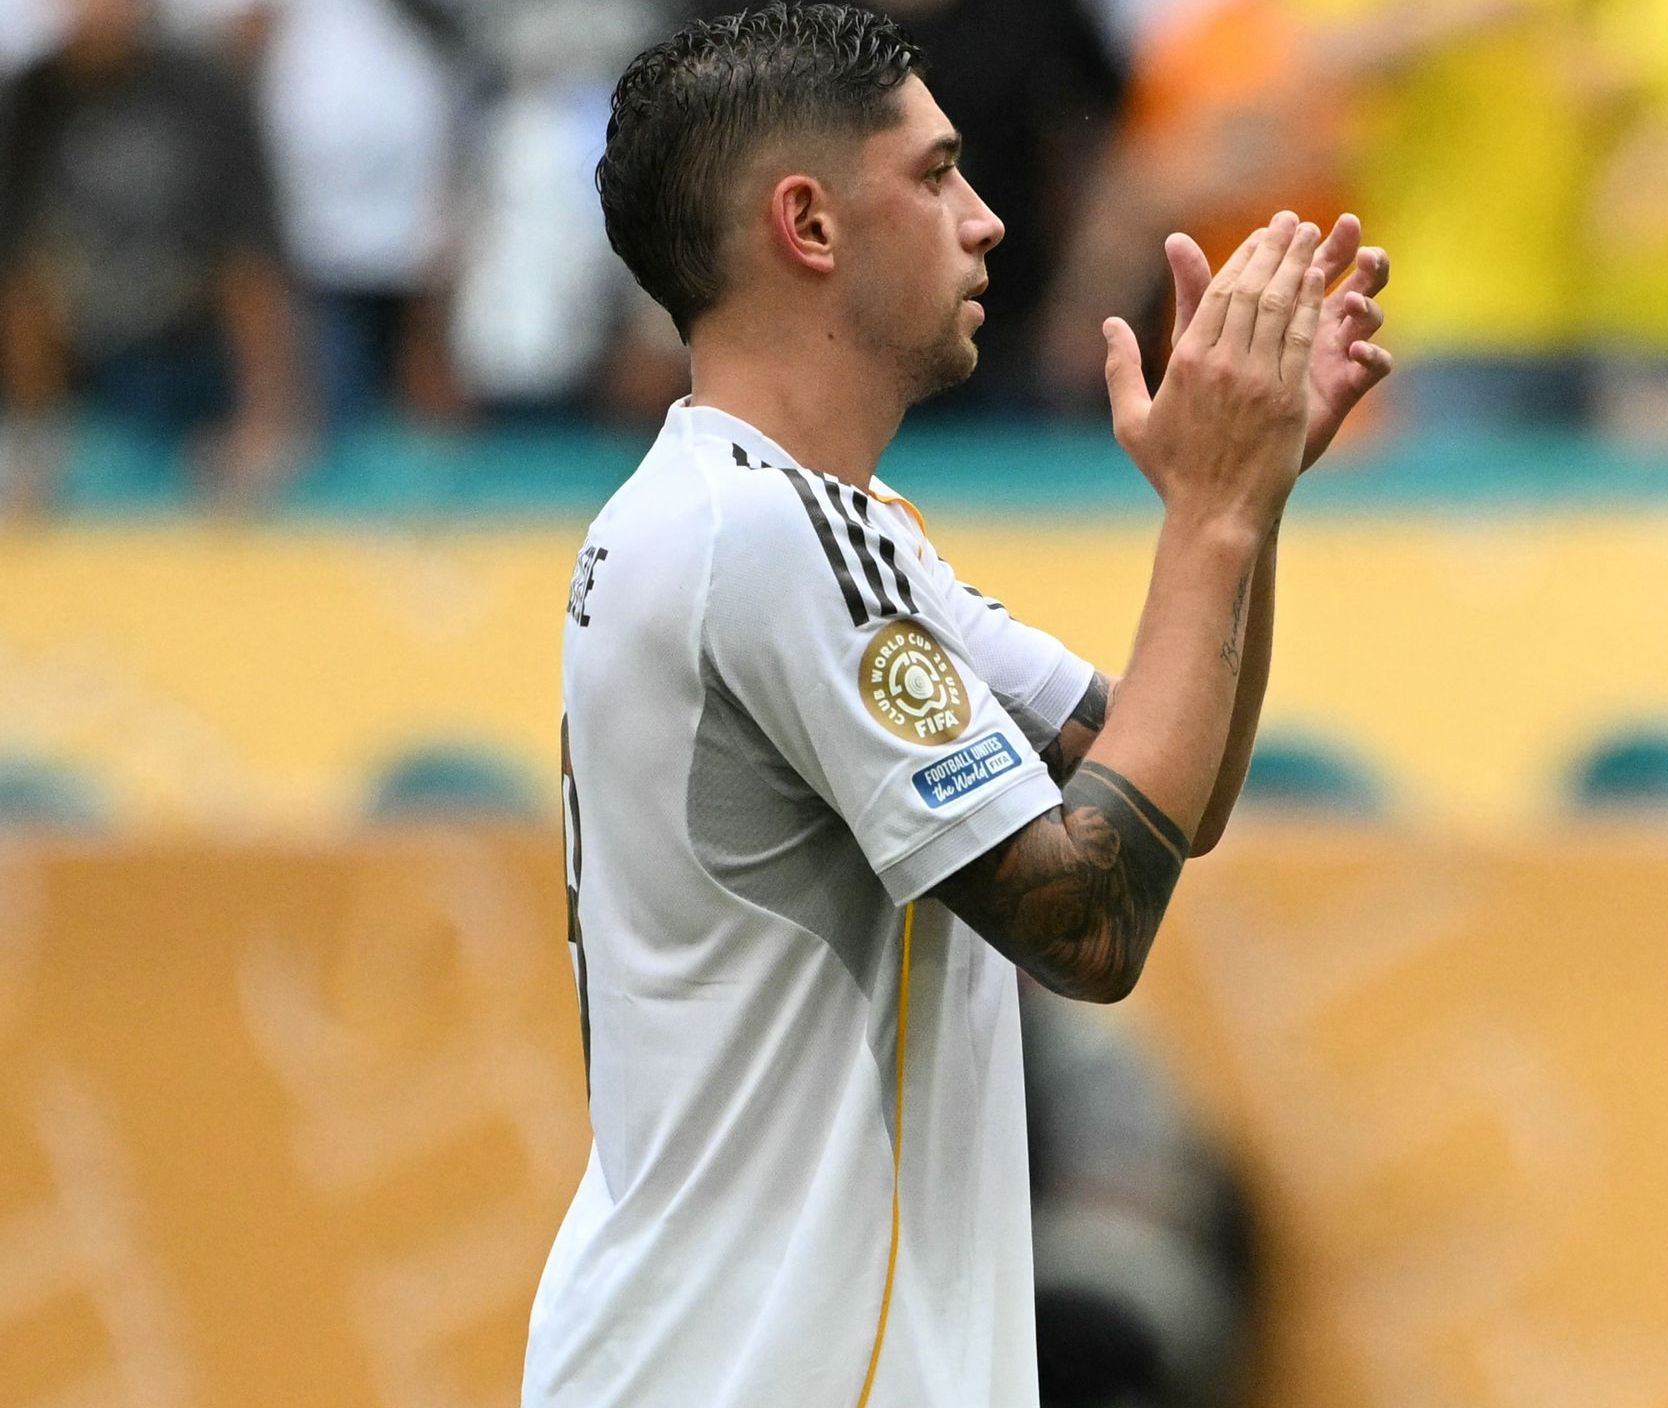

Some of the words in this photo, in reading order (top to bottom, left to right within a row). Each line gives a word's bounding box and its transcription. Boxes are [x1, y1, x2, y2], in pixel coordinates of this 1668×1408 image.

[908, 633, 932, 651] CUP
[871, 634, 905, 683] WORLD
[933, 653, 947, 672] 25
[945, 676, 960, 705] USA
[873, 690, 905, 725] CLUB
[914, 711, 959, 738] FIFA
[924, 750, 974, 786] FOOTBALL
[972, 736, 1002, 760] UNITES
[989, 756, 1010, 772] FIFA
[932, 778, 955, 802] the
[954, 763, 988, 793] World
